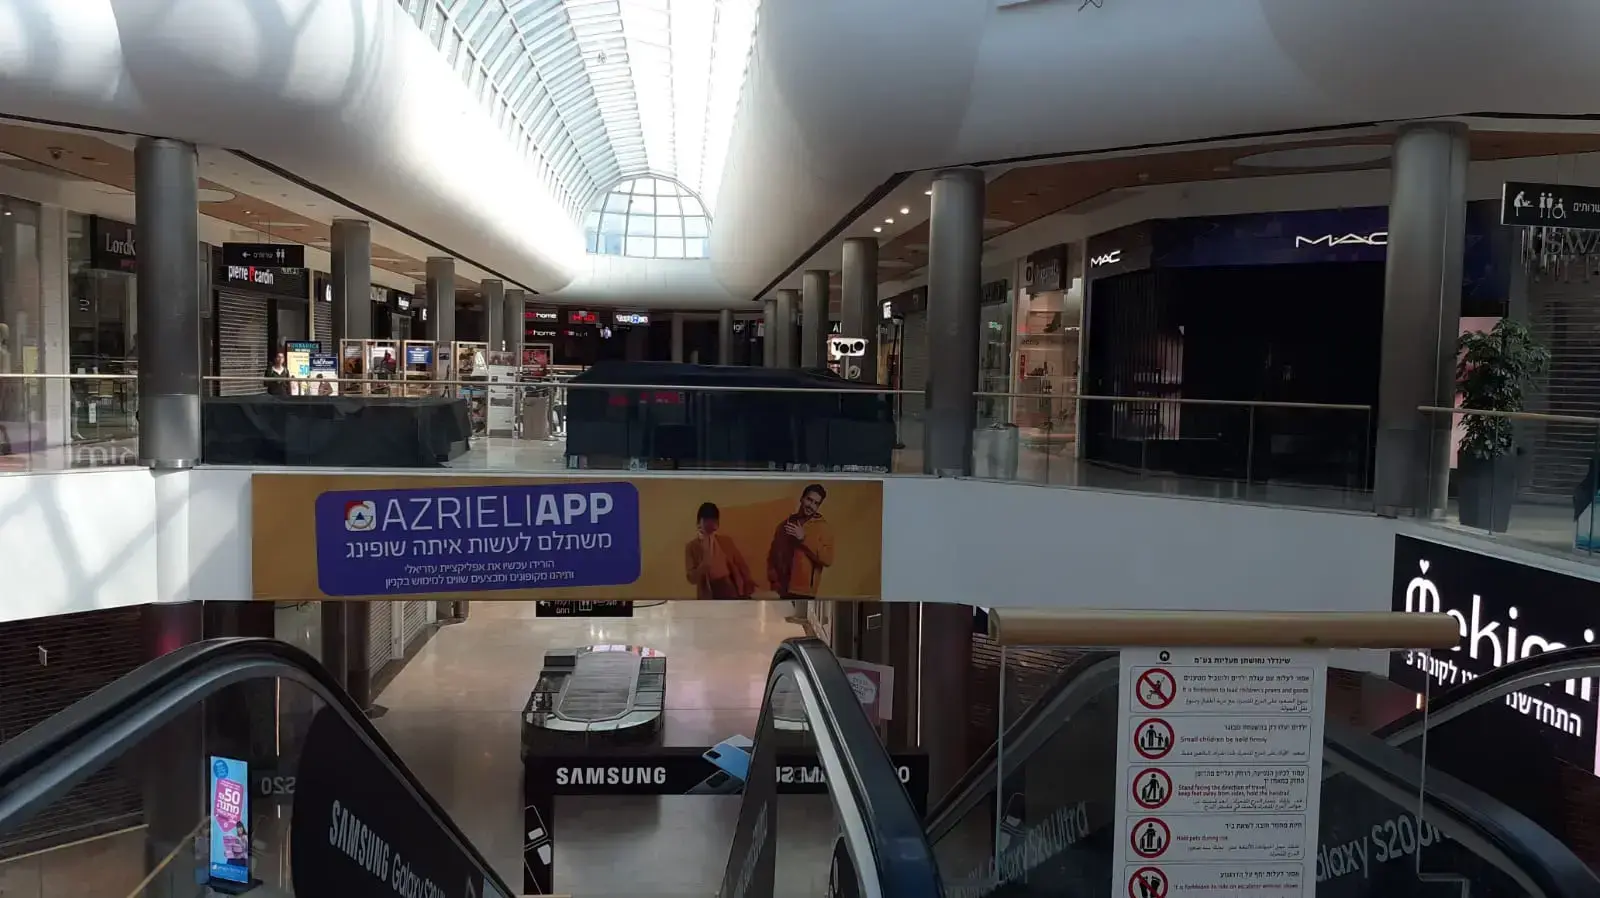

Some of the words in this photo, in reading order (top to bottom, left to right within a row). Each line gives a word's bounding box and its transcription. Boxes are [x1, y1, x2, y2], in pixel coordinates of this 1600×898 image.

[228, 266, 249, 282] pierre
[254, 269, 274, 285] cardin
[833, 341, 864, 354] YOLO
[381, 492, 614, 531] AZRIELIAPP
[345, 540, 407, 559] שופינג
[412, 538, 463, 556] איתה
[468, 532, 531, 554] לעשות
[538, 530, 612, 551] משתלם
[404, 564, 437, 574] עזריאלי
[487, 562, 503, 571] את
[503, 561, 528, 571] עכשיו
[529, 560, 555, 569] הורידו
[412, 575, 444, 586] למימוש
[471, 573, 508, 584] ומבצעים
[509, 571, 548, 583] מקופונים
[556, 766, 666, 785] SAMSUNG
[329, 799, 389, 882] SAMSUNG
[1371, 814, 1416, 862] S20
